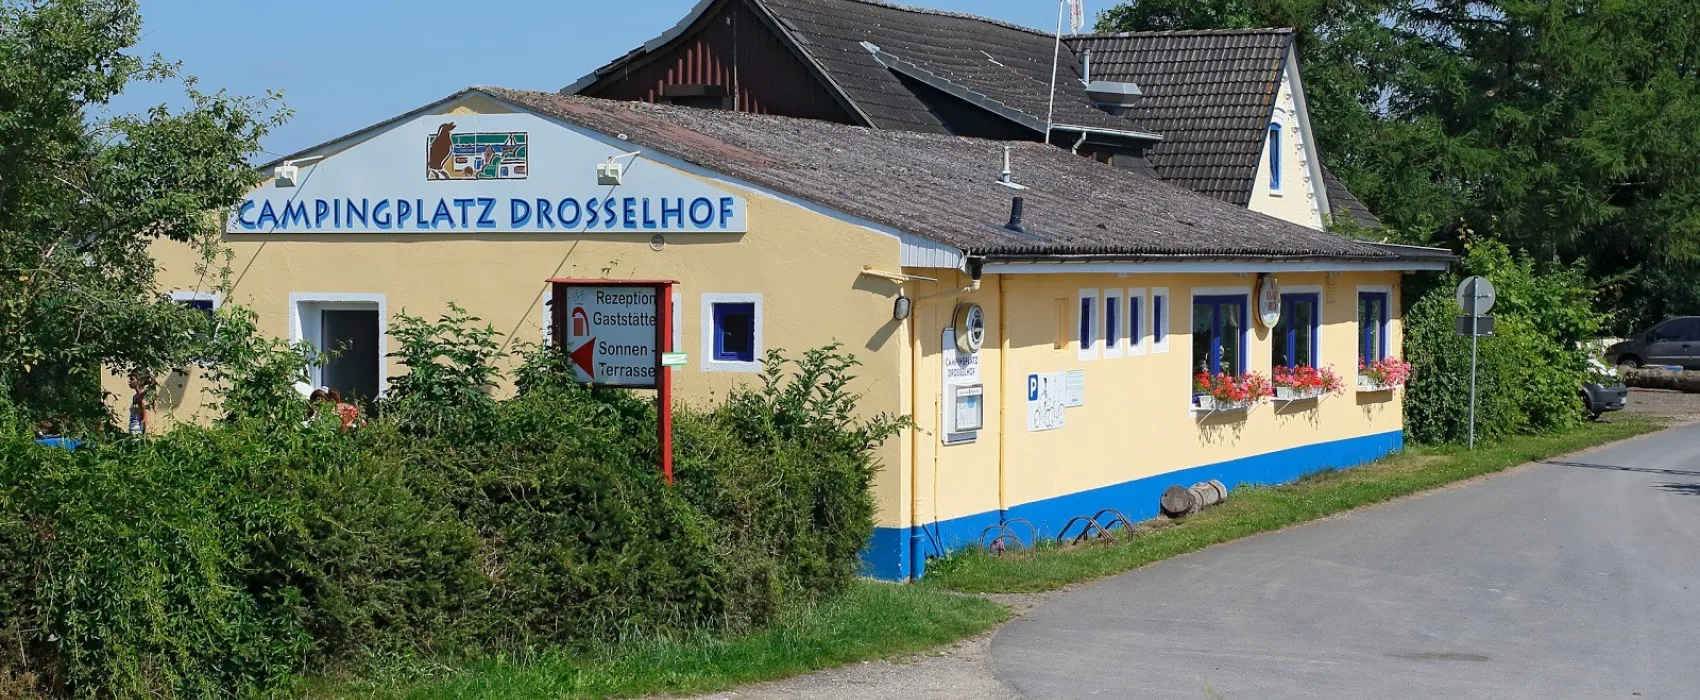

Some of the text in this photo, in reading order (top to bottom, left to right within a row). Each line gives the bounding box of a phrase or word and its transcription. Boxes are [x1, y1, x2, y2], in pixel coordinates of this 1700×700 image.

[239, 197, 734, 229] CAMPINGPLATZ DROSSELHOF
[596, 291, 656, 308] Rezeption
[593, 311, 656, 326] Gaststätte
[599, 341, 648, 356] Sonnen
[598, 362, 656, 377] Terrasse
[1030, 377, 1038, 398] P
